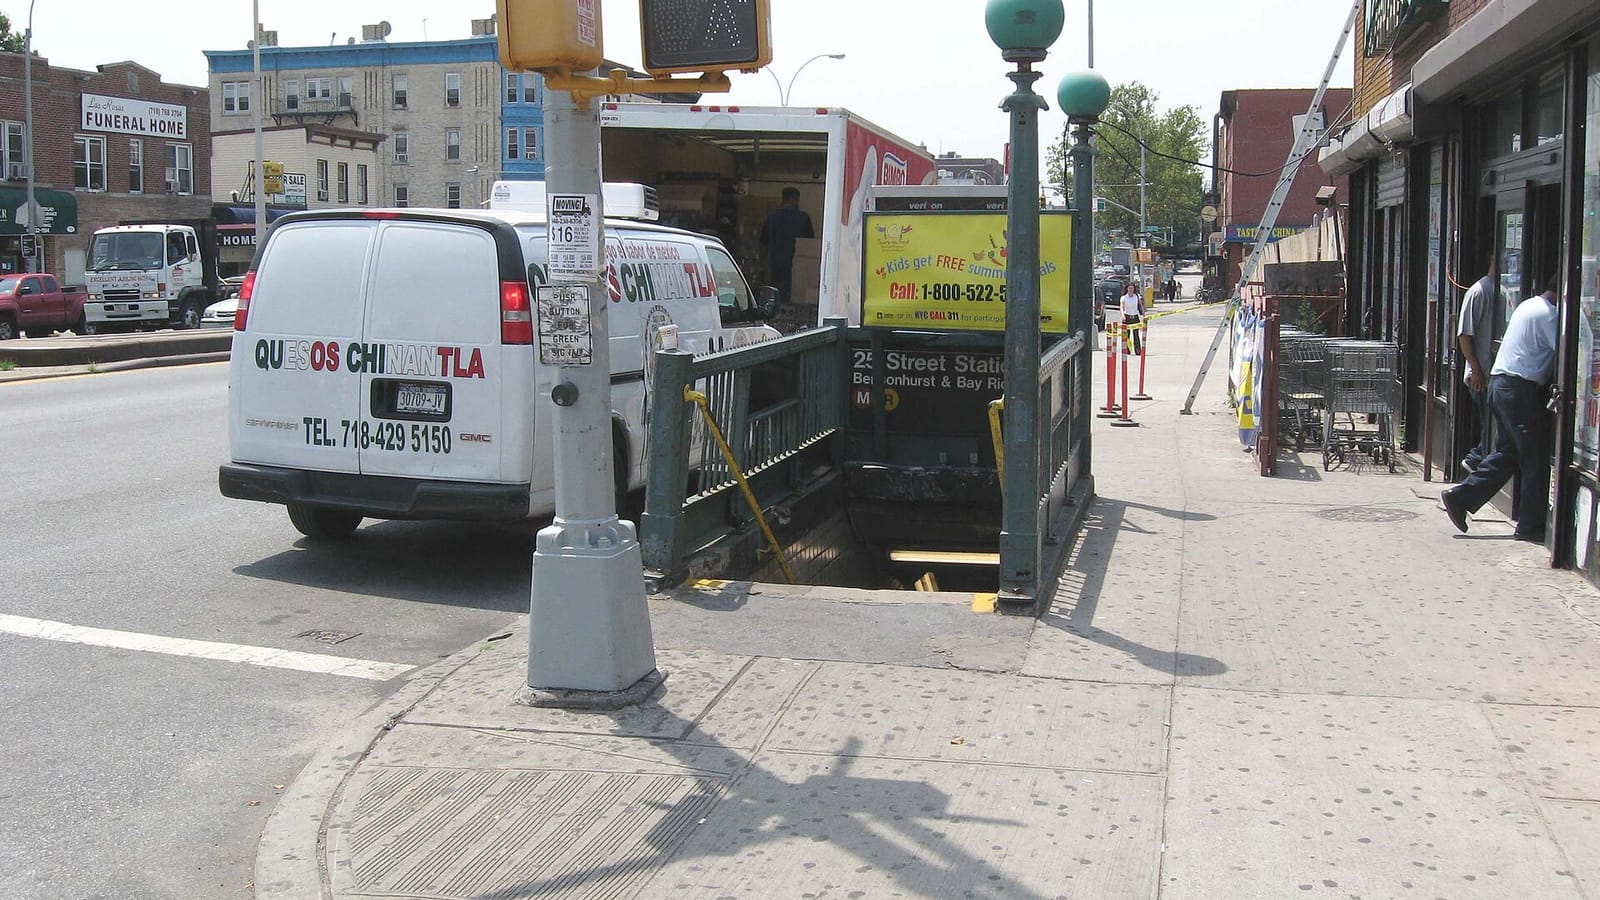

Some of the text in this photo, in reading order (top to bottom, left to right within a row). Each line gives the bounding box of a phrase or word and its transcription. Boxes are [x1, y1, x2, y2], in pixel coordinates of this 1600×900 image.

[86, 111, 183, 135] FUNERAL HOME
[884, 161, 905, 185] BIMBO
[289, 175, 304, 185] SALE
[555, 199, 583, 210] MOVING!
[909, 199, 1006, 209] verion veri
[551, 226, 573, 242] $16
[1272, 227, 1296, 238] CHINA
[223, 236, 256, 246] HOME
[887, 257, 910, 274] Kids
[913, 255, 933, 271] get
[936, 254, 966, 272] FREE
[1040, 260, 1056, 276] als
[620, 263, 717, 303] CHINANTLA
[553, 293, 576, 302] PUSH
[889, 282, 918, 300] Call:
[549, 307, 580, 316] BUTTON
[914, 311, 928, 320] NYC
[929, 311, 947, 320] CALL
[947, 311, 959, 320] 311
[552, 335, 579, 343] GREEN
[255, 338, 485, 379] QUESOS CHINANTLA
[886, 352, 946, 372] Street
[853, 372, 936, 387] Beonhurst
[941, 375, 951, 387] &
[957, 376, 982, 391] Bay
[857, 391, 870, 404] M
[303, 417, 451, 454] TEL. 718-429 5150
[459, 432, 492, 443] GMC
